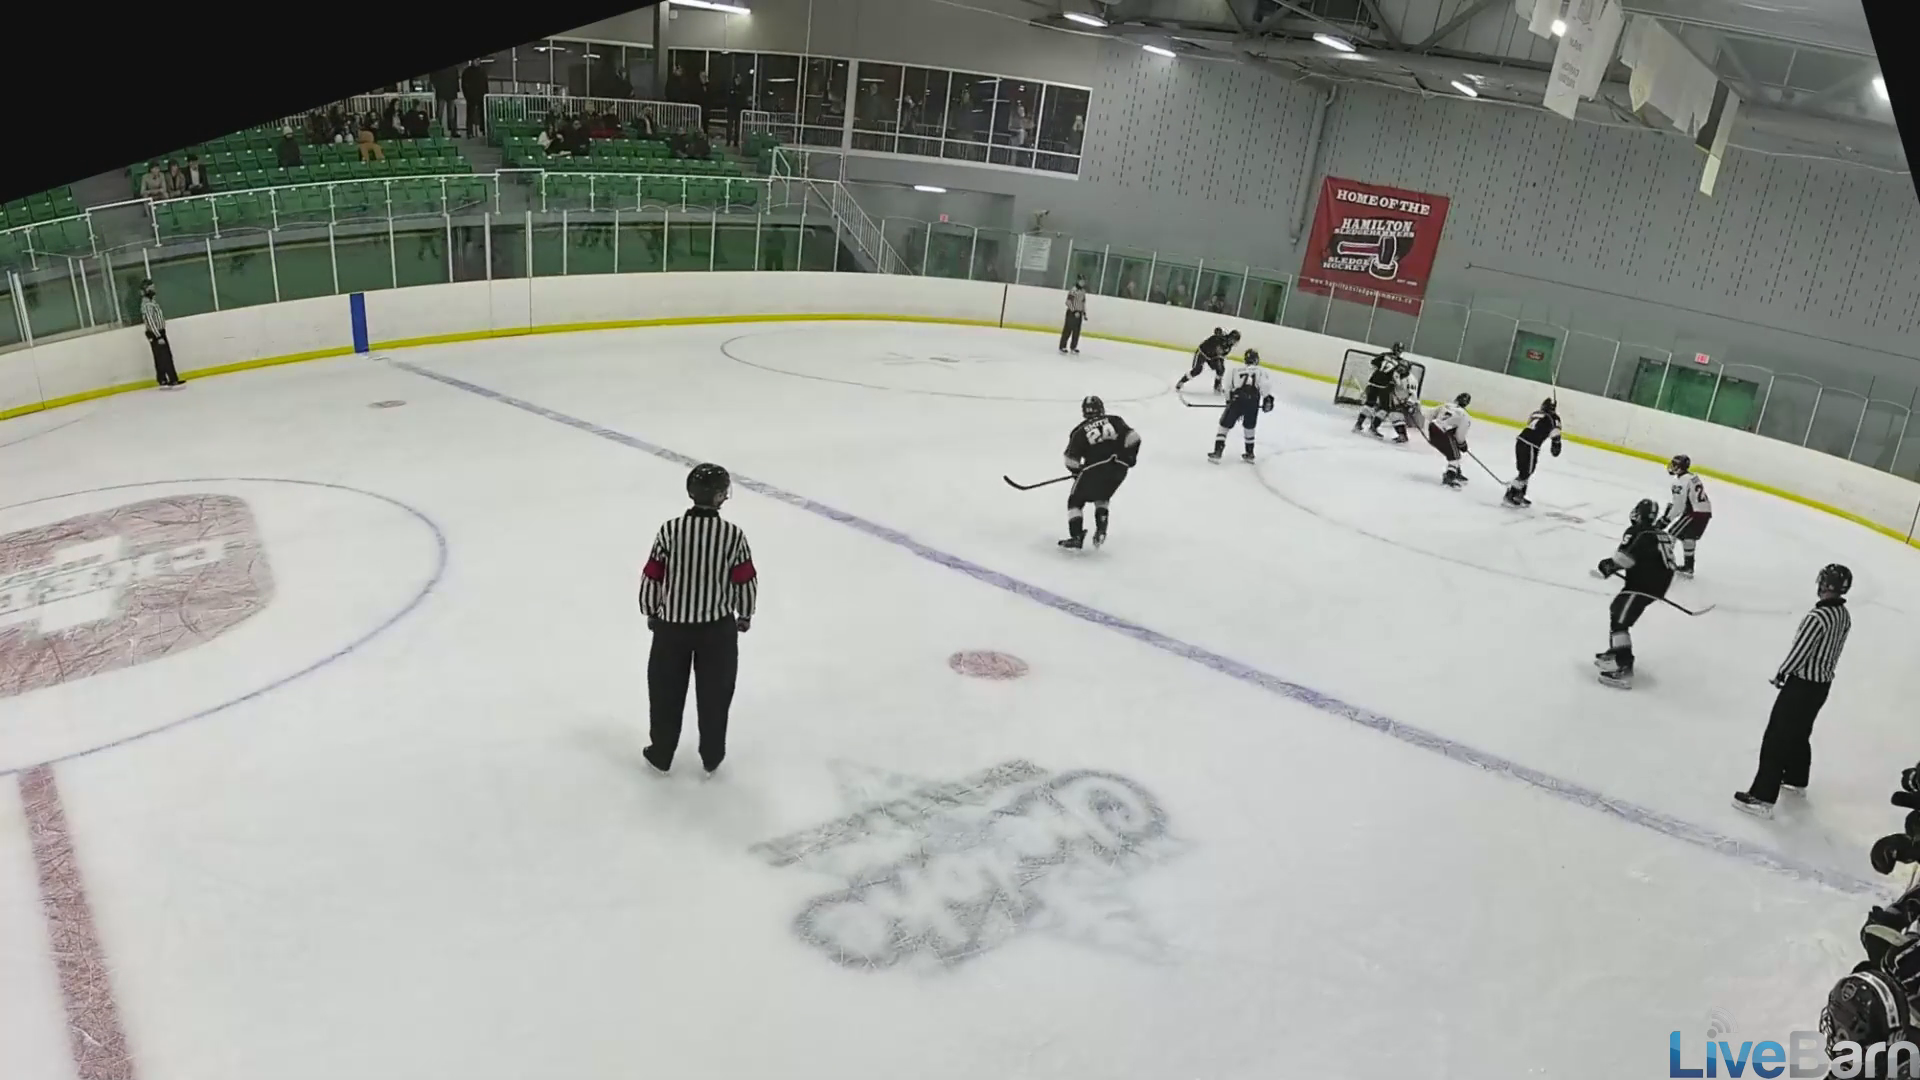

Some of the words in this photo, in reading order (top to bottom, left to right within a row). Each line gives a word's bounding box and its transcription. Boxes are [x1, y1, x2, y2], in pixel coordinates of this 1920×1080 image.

[1336, 189, 1378, 205] HOME
[1379, 198, 1400, 209] OF
[1401, 201, 1430, 215] THE
[1333, 228, 1415, 238] SLEDGEHAMMERS
[1341, 218, 1414, 233] HAMILTON
[1323, 262, 1368, 272] HOCKEY
[1328, 256, 1370, 267] SLEDGE
[1239, 372, 1257, 387] 71
[1086, 422, 1119, 445] 24
